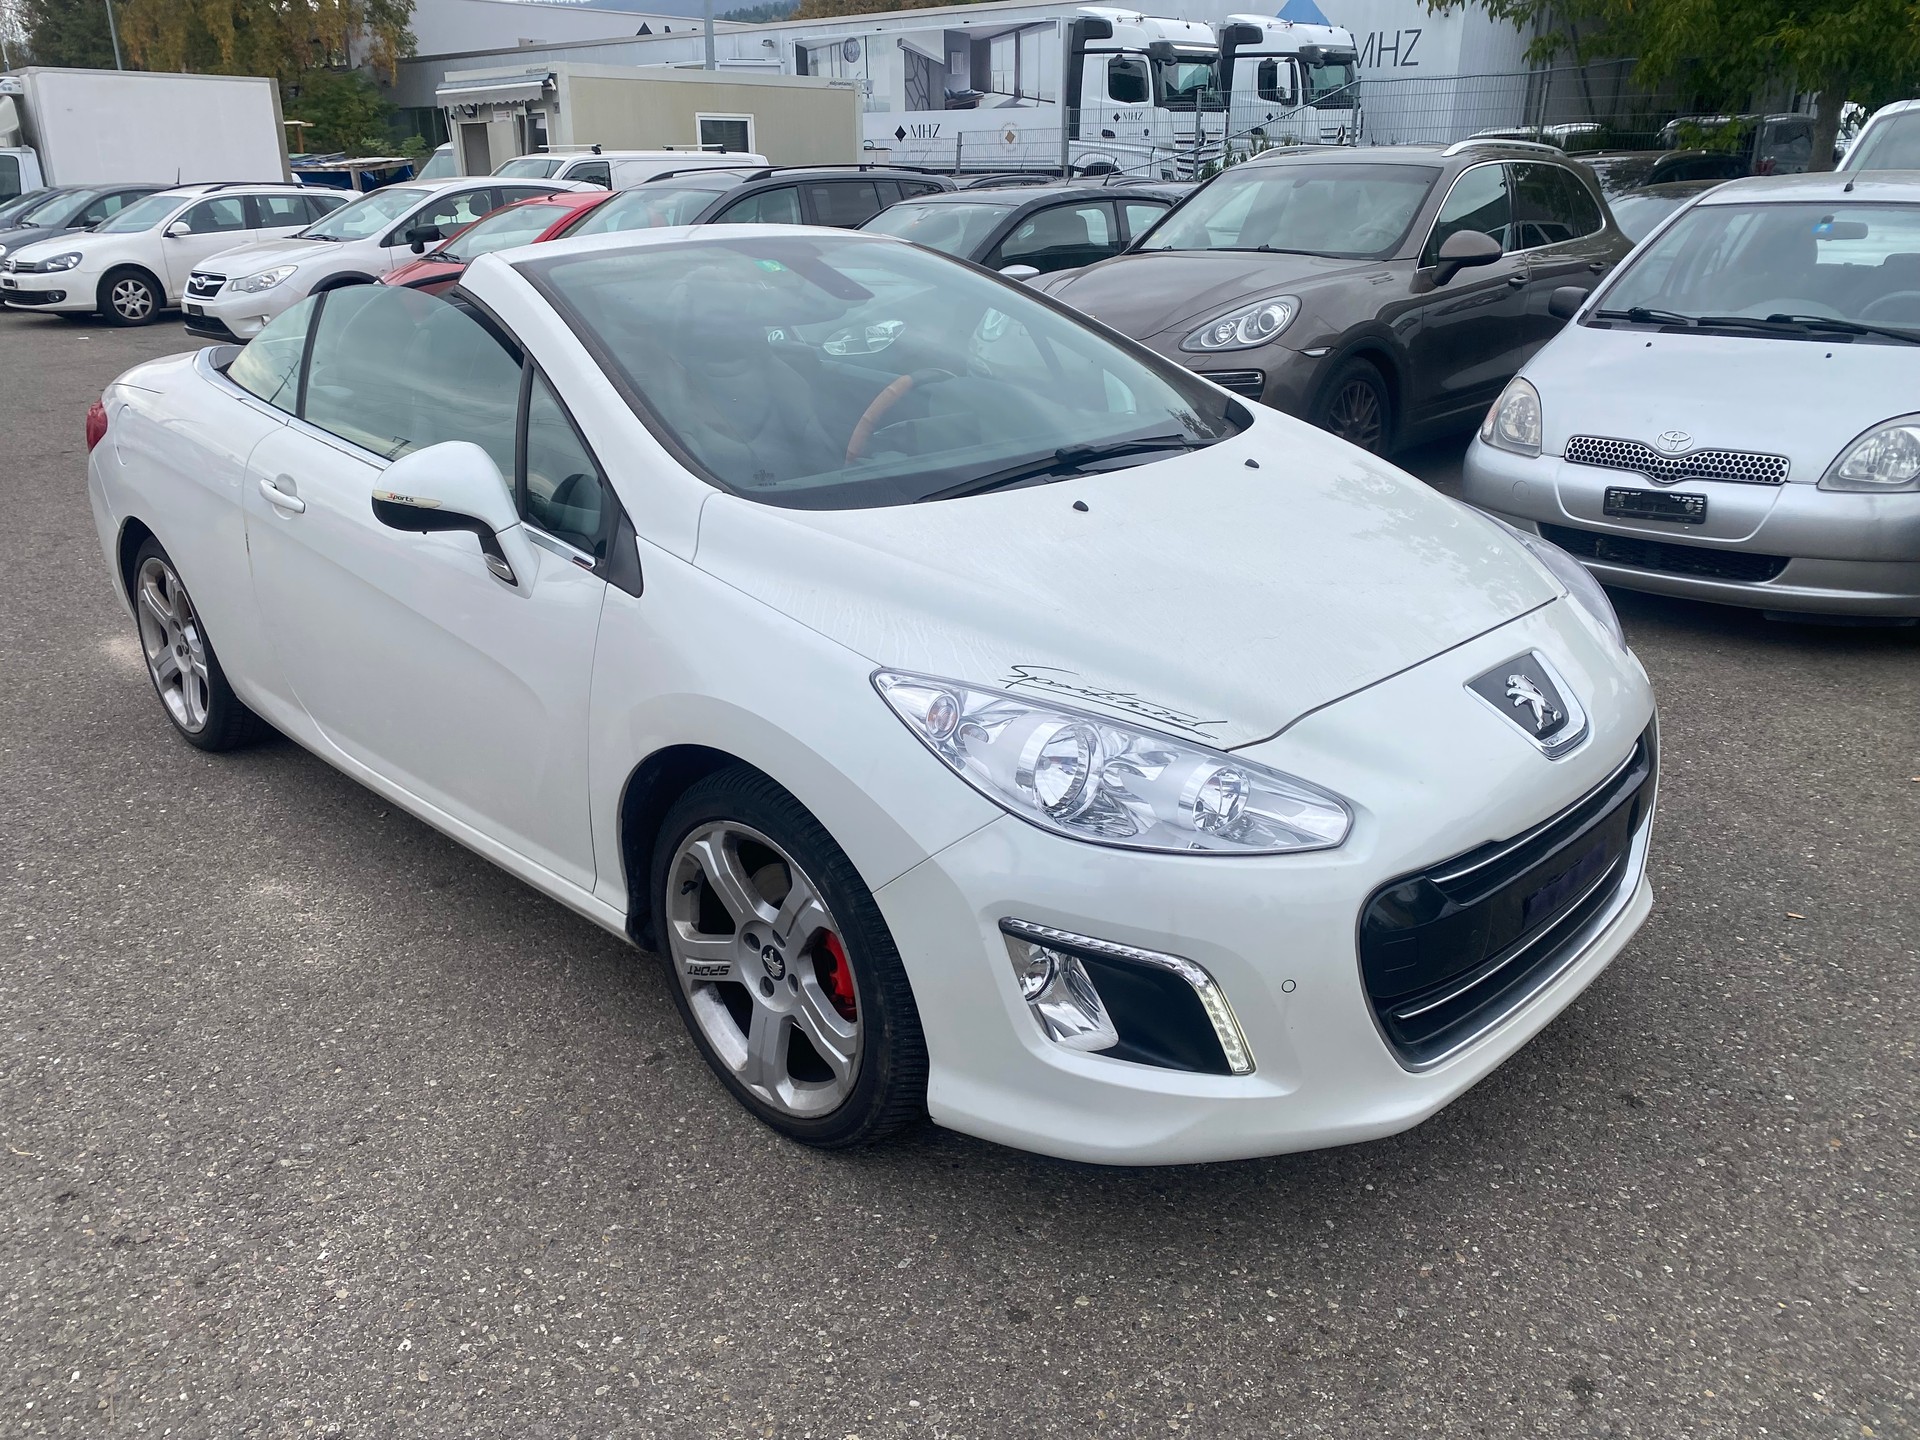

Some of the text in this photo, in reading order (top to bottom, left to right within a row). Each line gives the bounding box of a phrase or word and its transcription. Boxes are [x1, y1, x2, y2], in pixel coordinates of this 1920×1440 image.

[1350, 29, 1422, 69] MHZ
[910, 123, 941, 139] MHZ
[687, 965, 731, 976] SPORT
